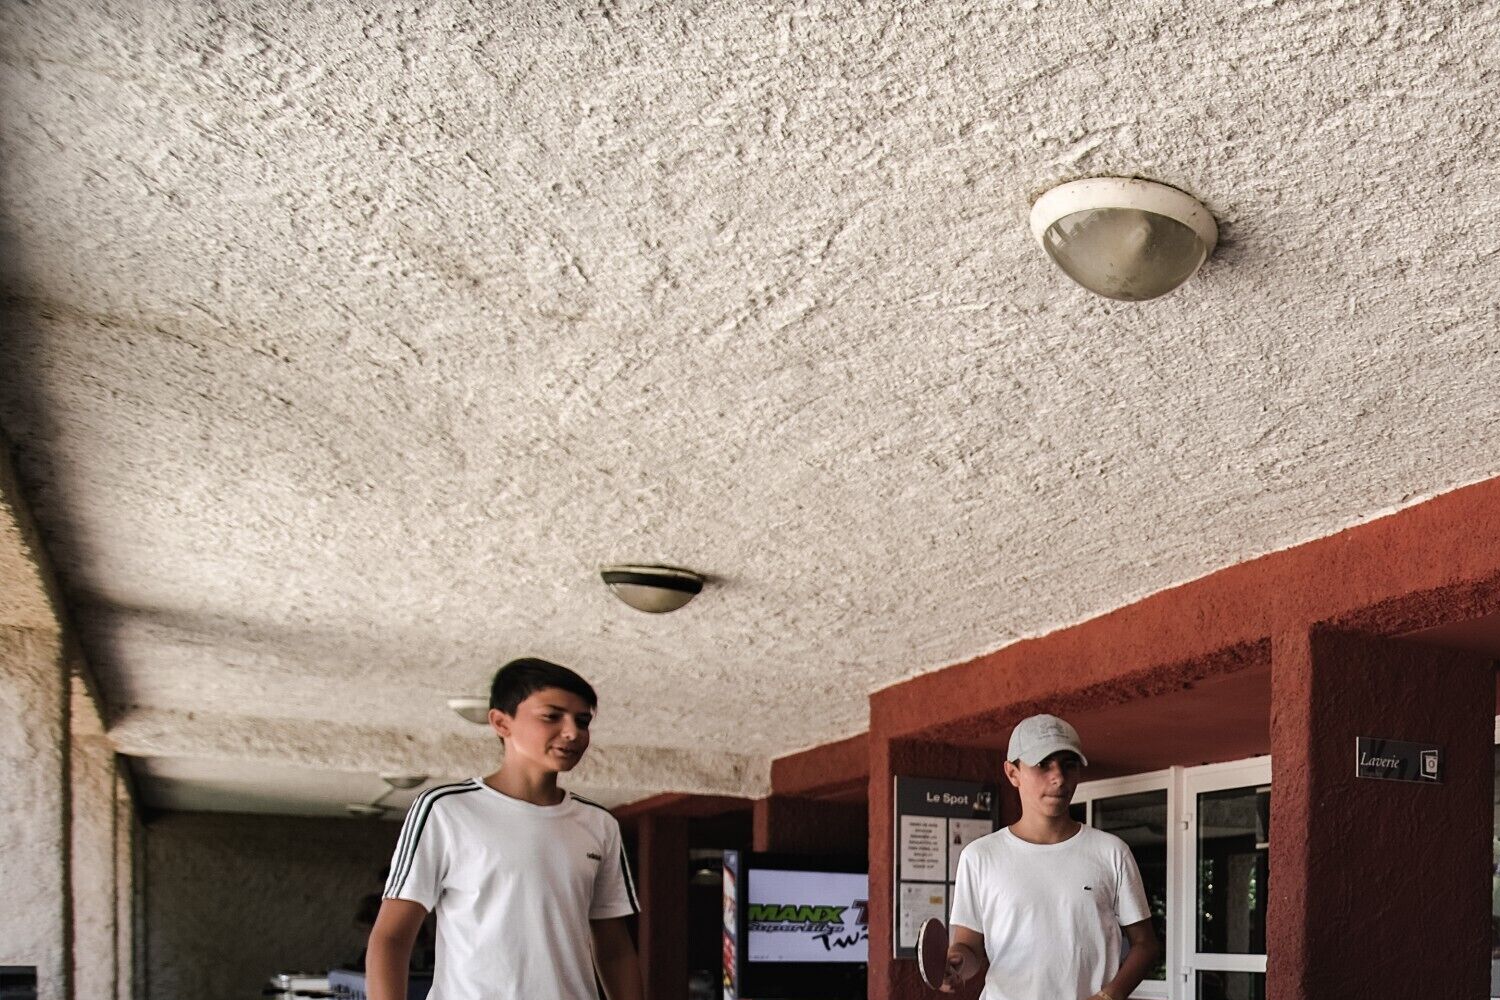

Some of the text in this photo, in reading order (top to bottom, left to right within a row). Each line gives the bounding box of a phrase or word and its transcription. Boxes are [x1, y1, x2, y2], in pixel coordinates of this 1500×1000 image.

[1360, 752, 1400, 769] Laverie
[926, 791, 969, 805] Le Spot
[748, 903, 848, 925] MANX
